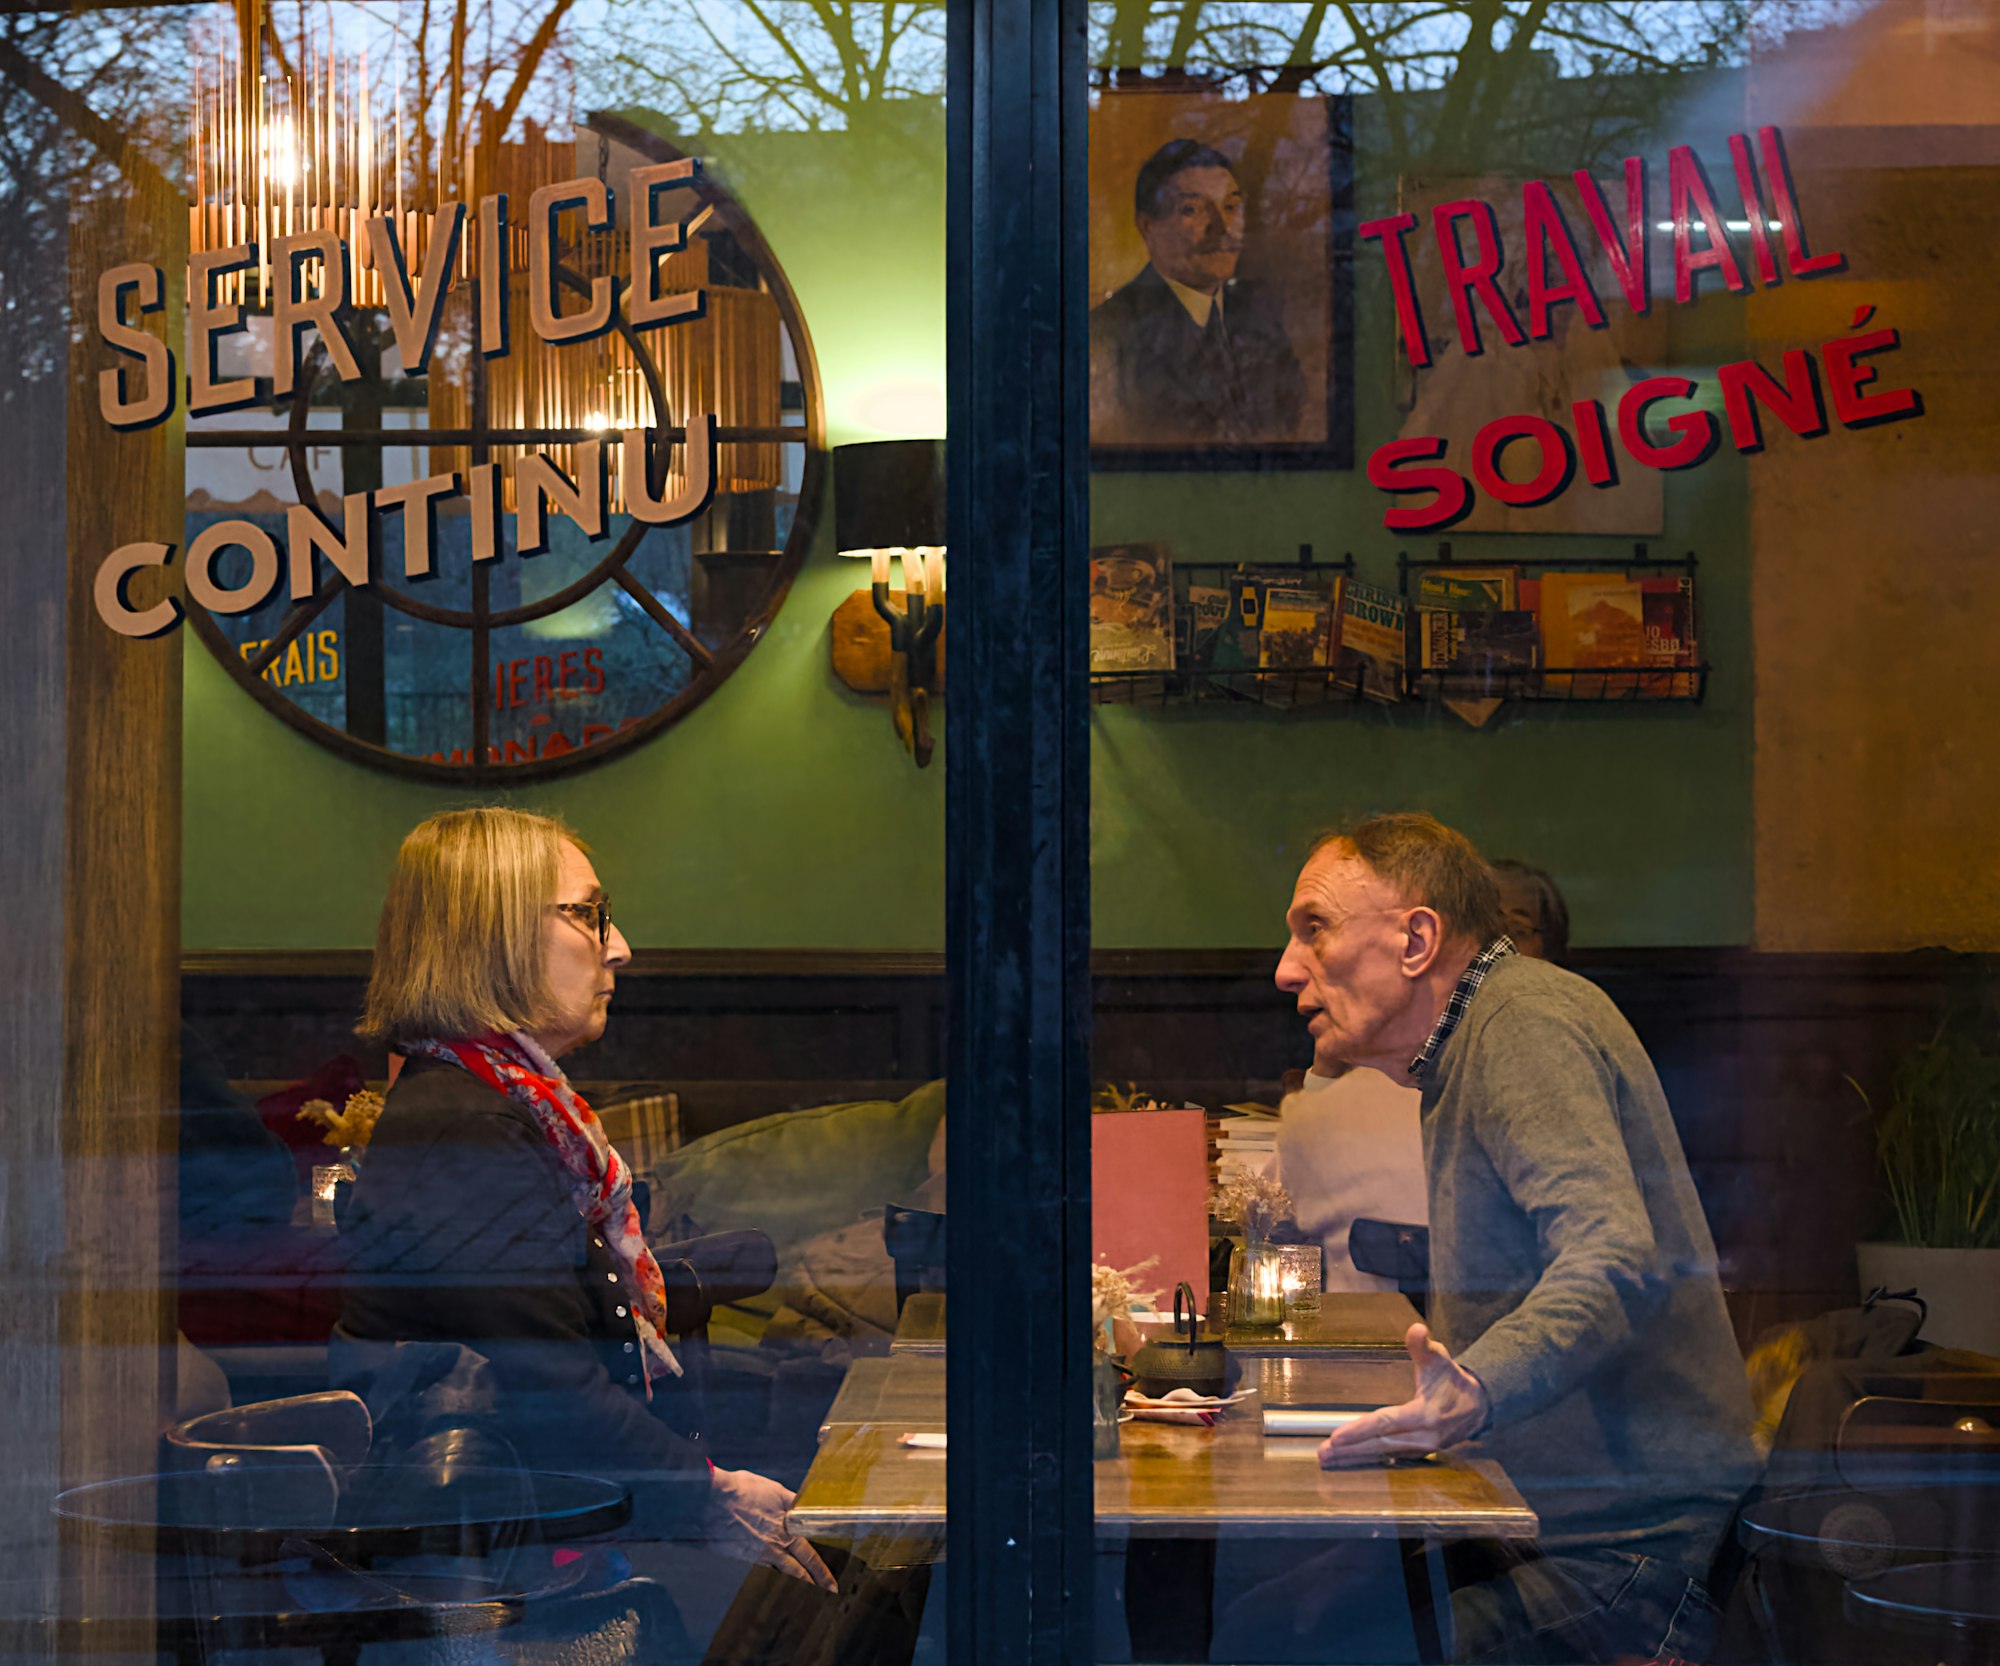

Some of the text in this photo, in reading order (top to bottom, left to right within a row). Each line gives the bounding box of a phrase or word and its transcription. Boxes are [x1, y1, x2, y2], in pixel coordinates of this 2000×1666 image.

[98, 157, 705, 431] SERVICE
[1359, 125, 1848, 367] TRAVAIL
[93, 413, 716, 638] CONTINU
[1367, 305, 1924, 533] SOIGNÉ
[471, 647, 605, 710] IERES
